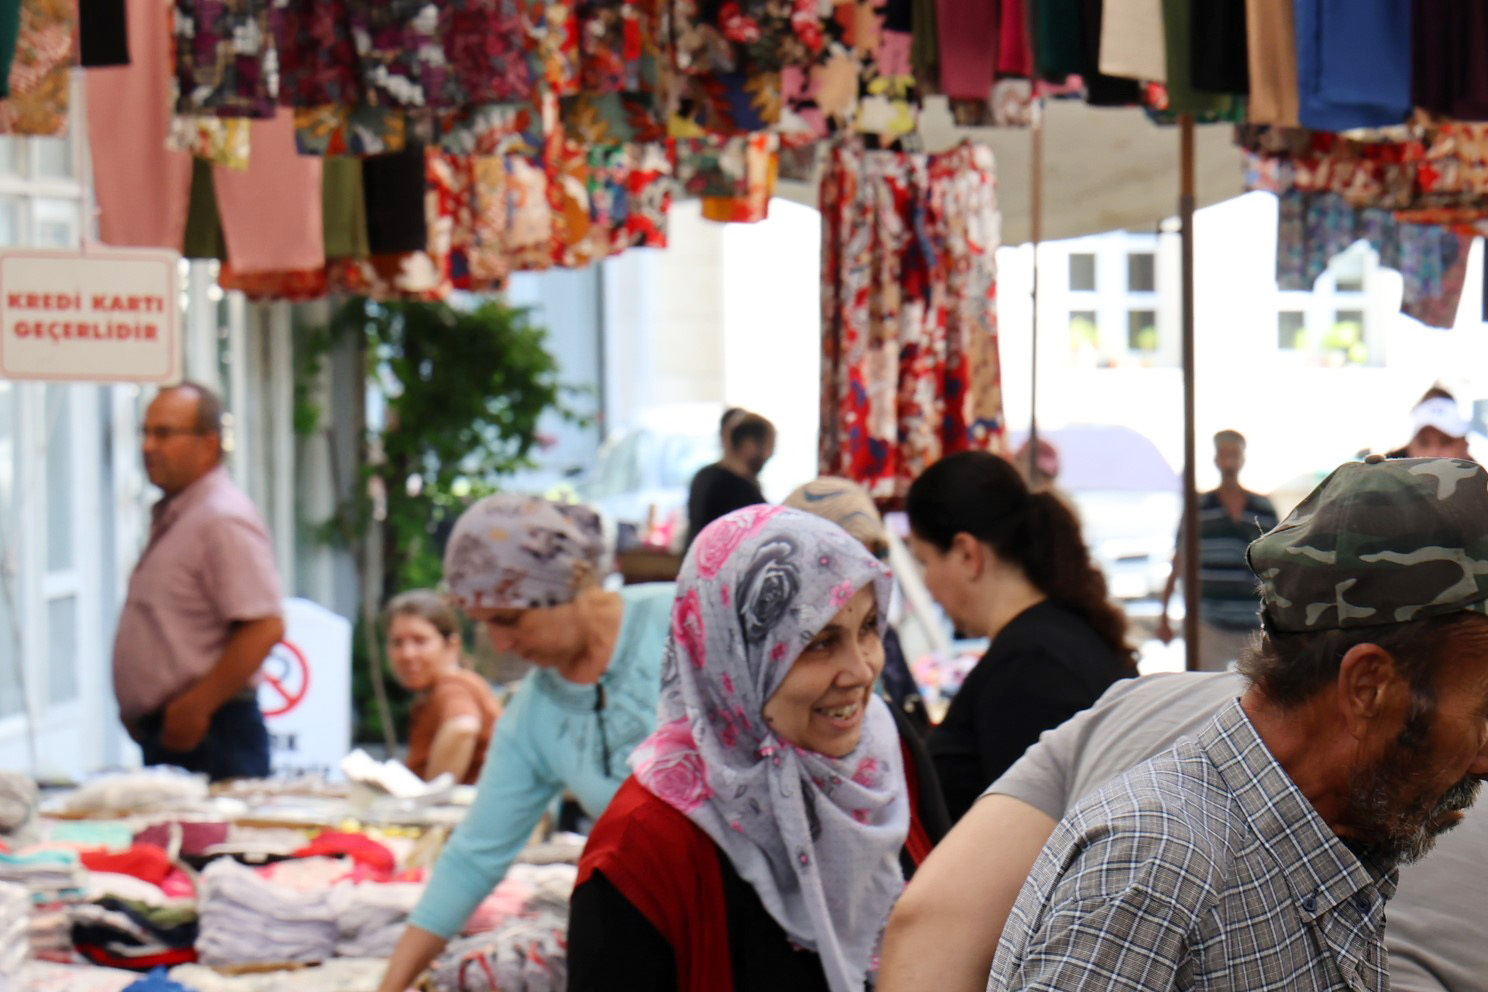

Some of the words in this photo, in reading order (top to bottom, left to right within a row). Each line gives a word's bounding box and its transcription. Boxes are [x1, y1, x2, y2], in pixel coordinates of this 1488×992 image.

[7, 291, 82, 310] KREDİ
[92, 294, 165, 312] KARTI
[13, 320, 158, 342] GEÇERLİDİR
